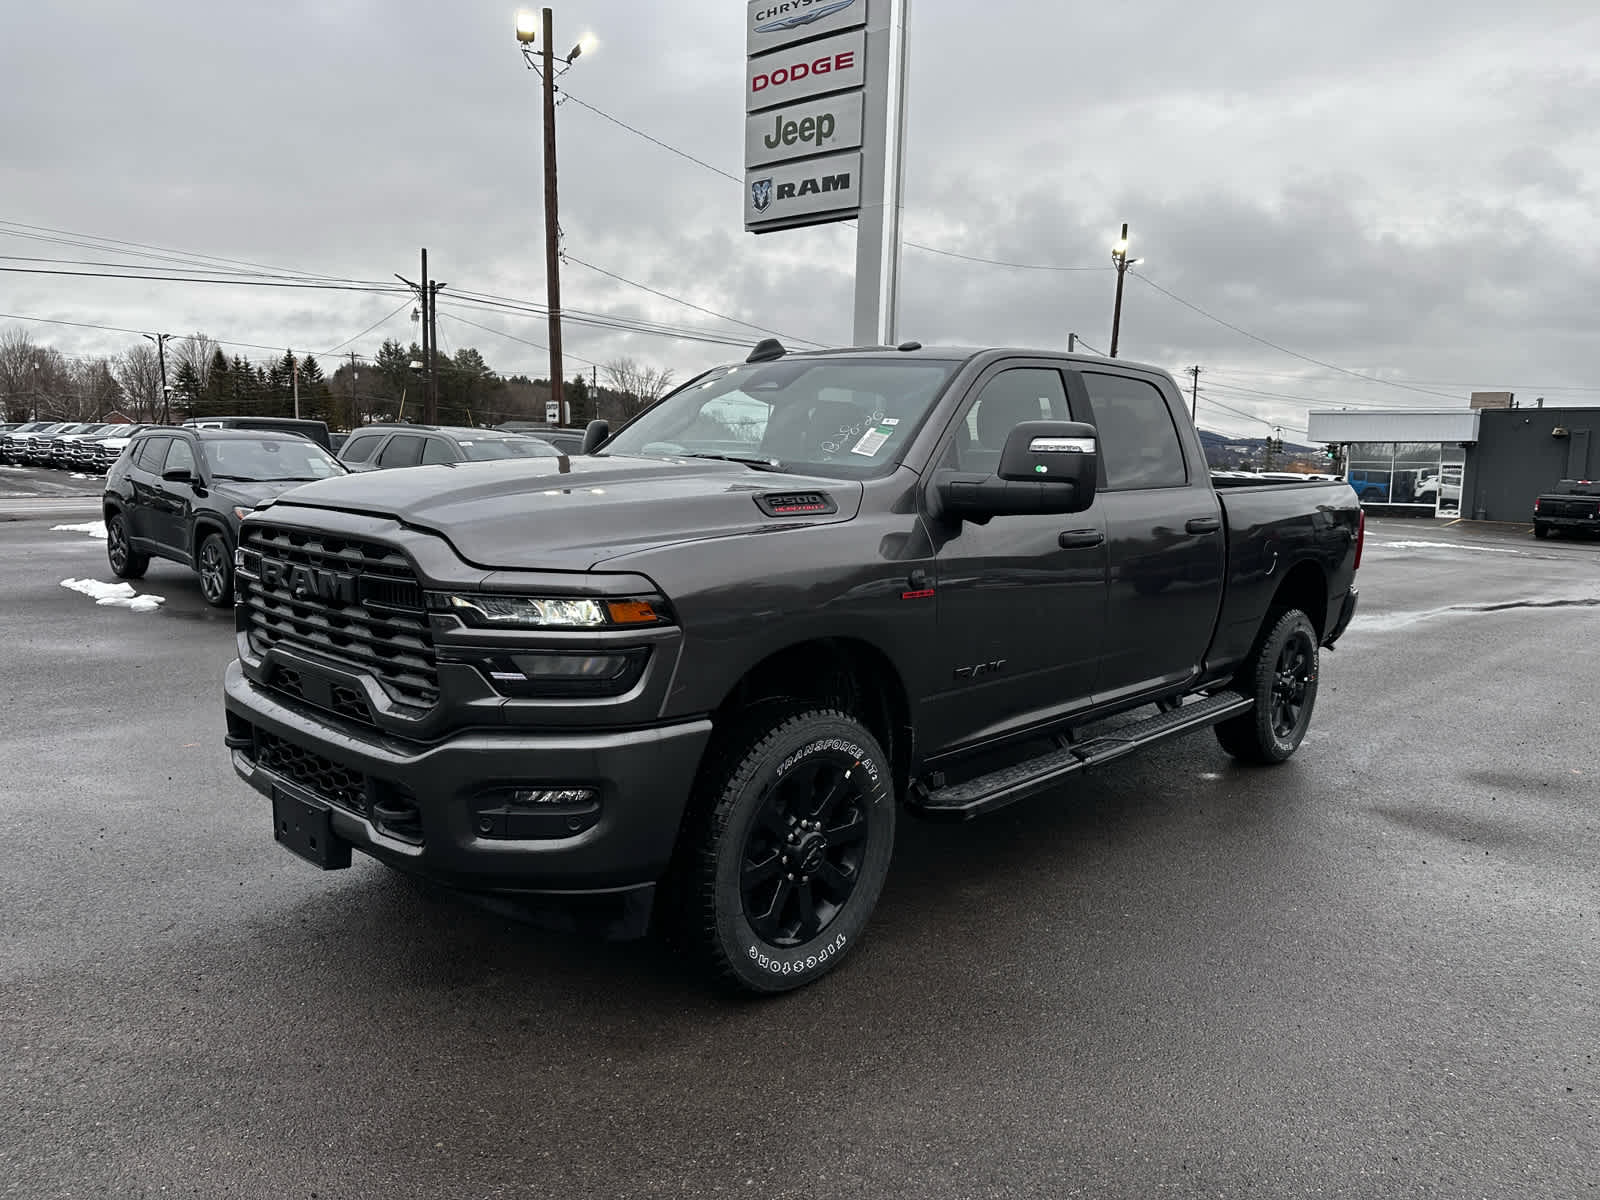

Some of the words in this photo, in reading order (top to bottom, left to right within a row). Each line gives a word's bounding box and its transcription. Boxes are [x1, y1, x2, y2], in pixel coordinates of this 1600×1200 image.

[755, 0, 822, 21] CHRYS
[752, 51, 855, 92] DODGE
[764, 112, 835, 149] Jeep
[776, 172, 851, 200] RAM
[769, 495, 820, 505] 2500
[261, 557, 357, 603] RAM
[776, 738, 865, 777] TRANSFORCE
